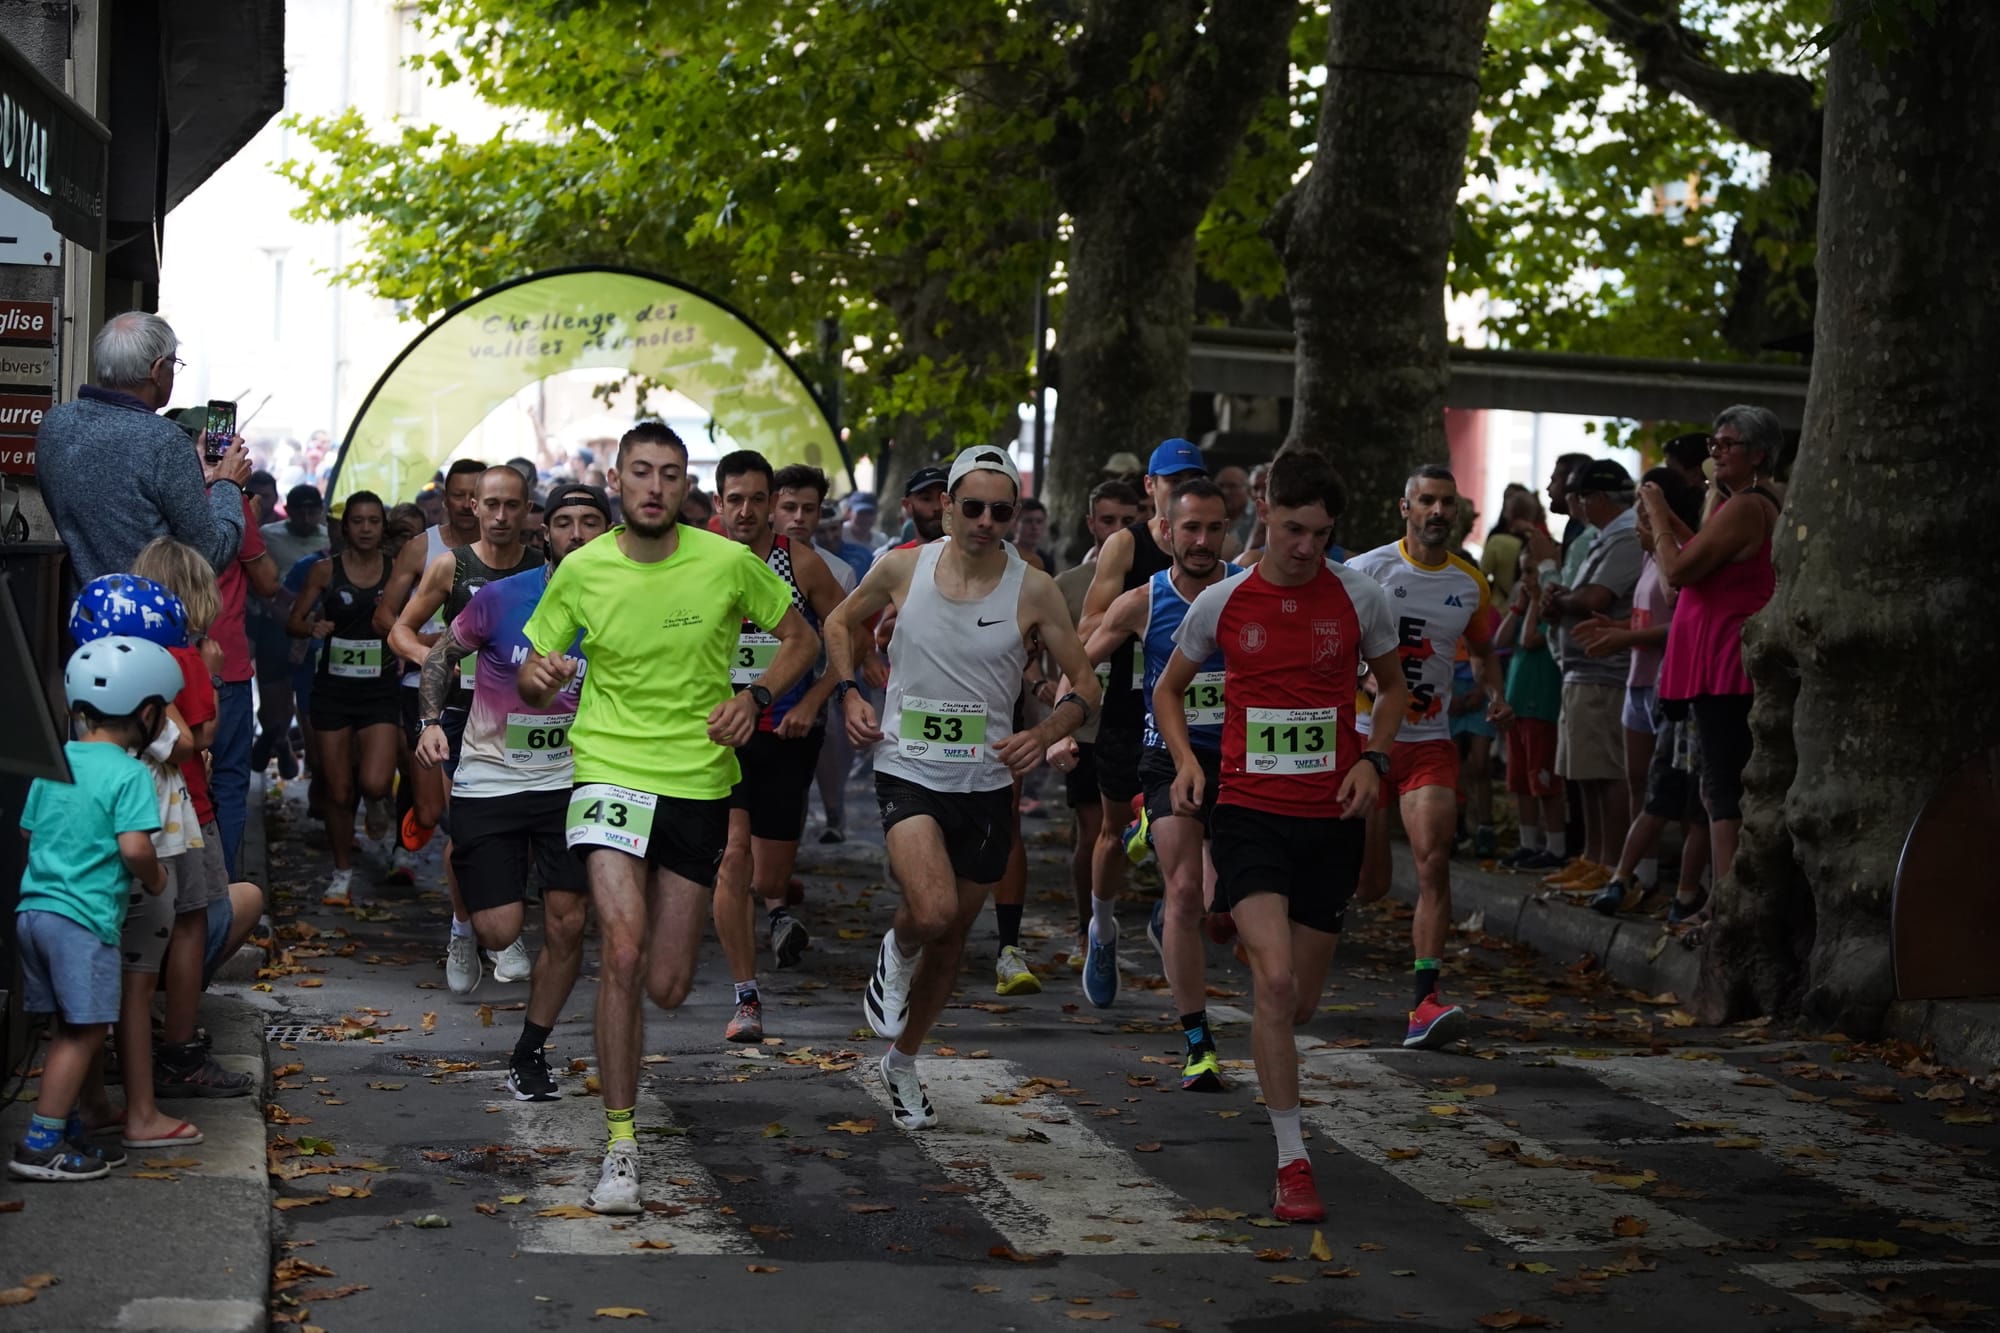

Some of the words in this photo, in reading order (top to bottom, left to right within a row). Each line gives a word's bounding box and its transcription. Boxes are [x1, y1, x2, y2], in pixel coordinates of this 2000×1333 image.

[0, 91, 52, 196] UYAL
[482, 311, 616, 336] Challenge
[635, 303, 679, 324] des
[469, 335, 564, 359] vallées
[1314, 627, 1339, 635] TRAIL
[342, 650, 366, 665] 21
[1184, 686, 1225, 707] 13
[527, 728, 565, 749] 60
[923, 715, 963, 742] 53
[1260, 726, 1325, 753] 113
[583, 799, 628, 827] 43
